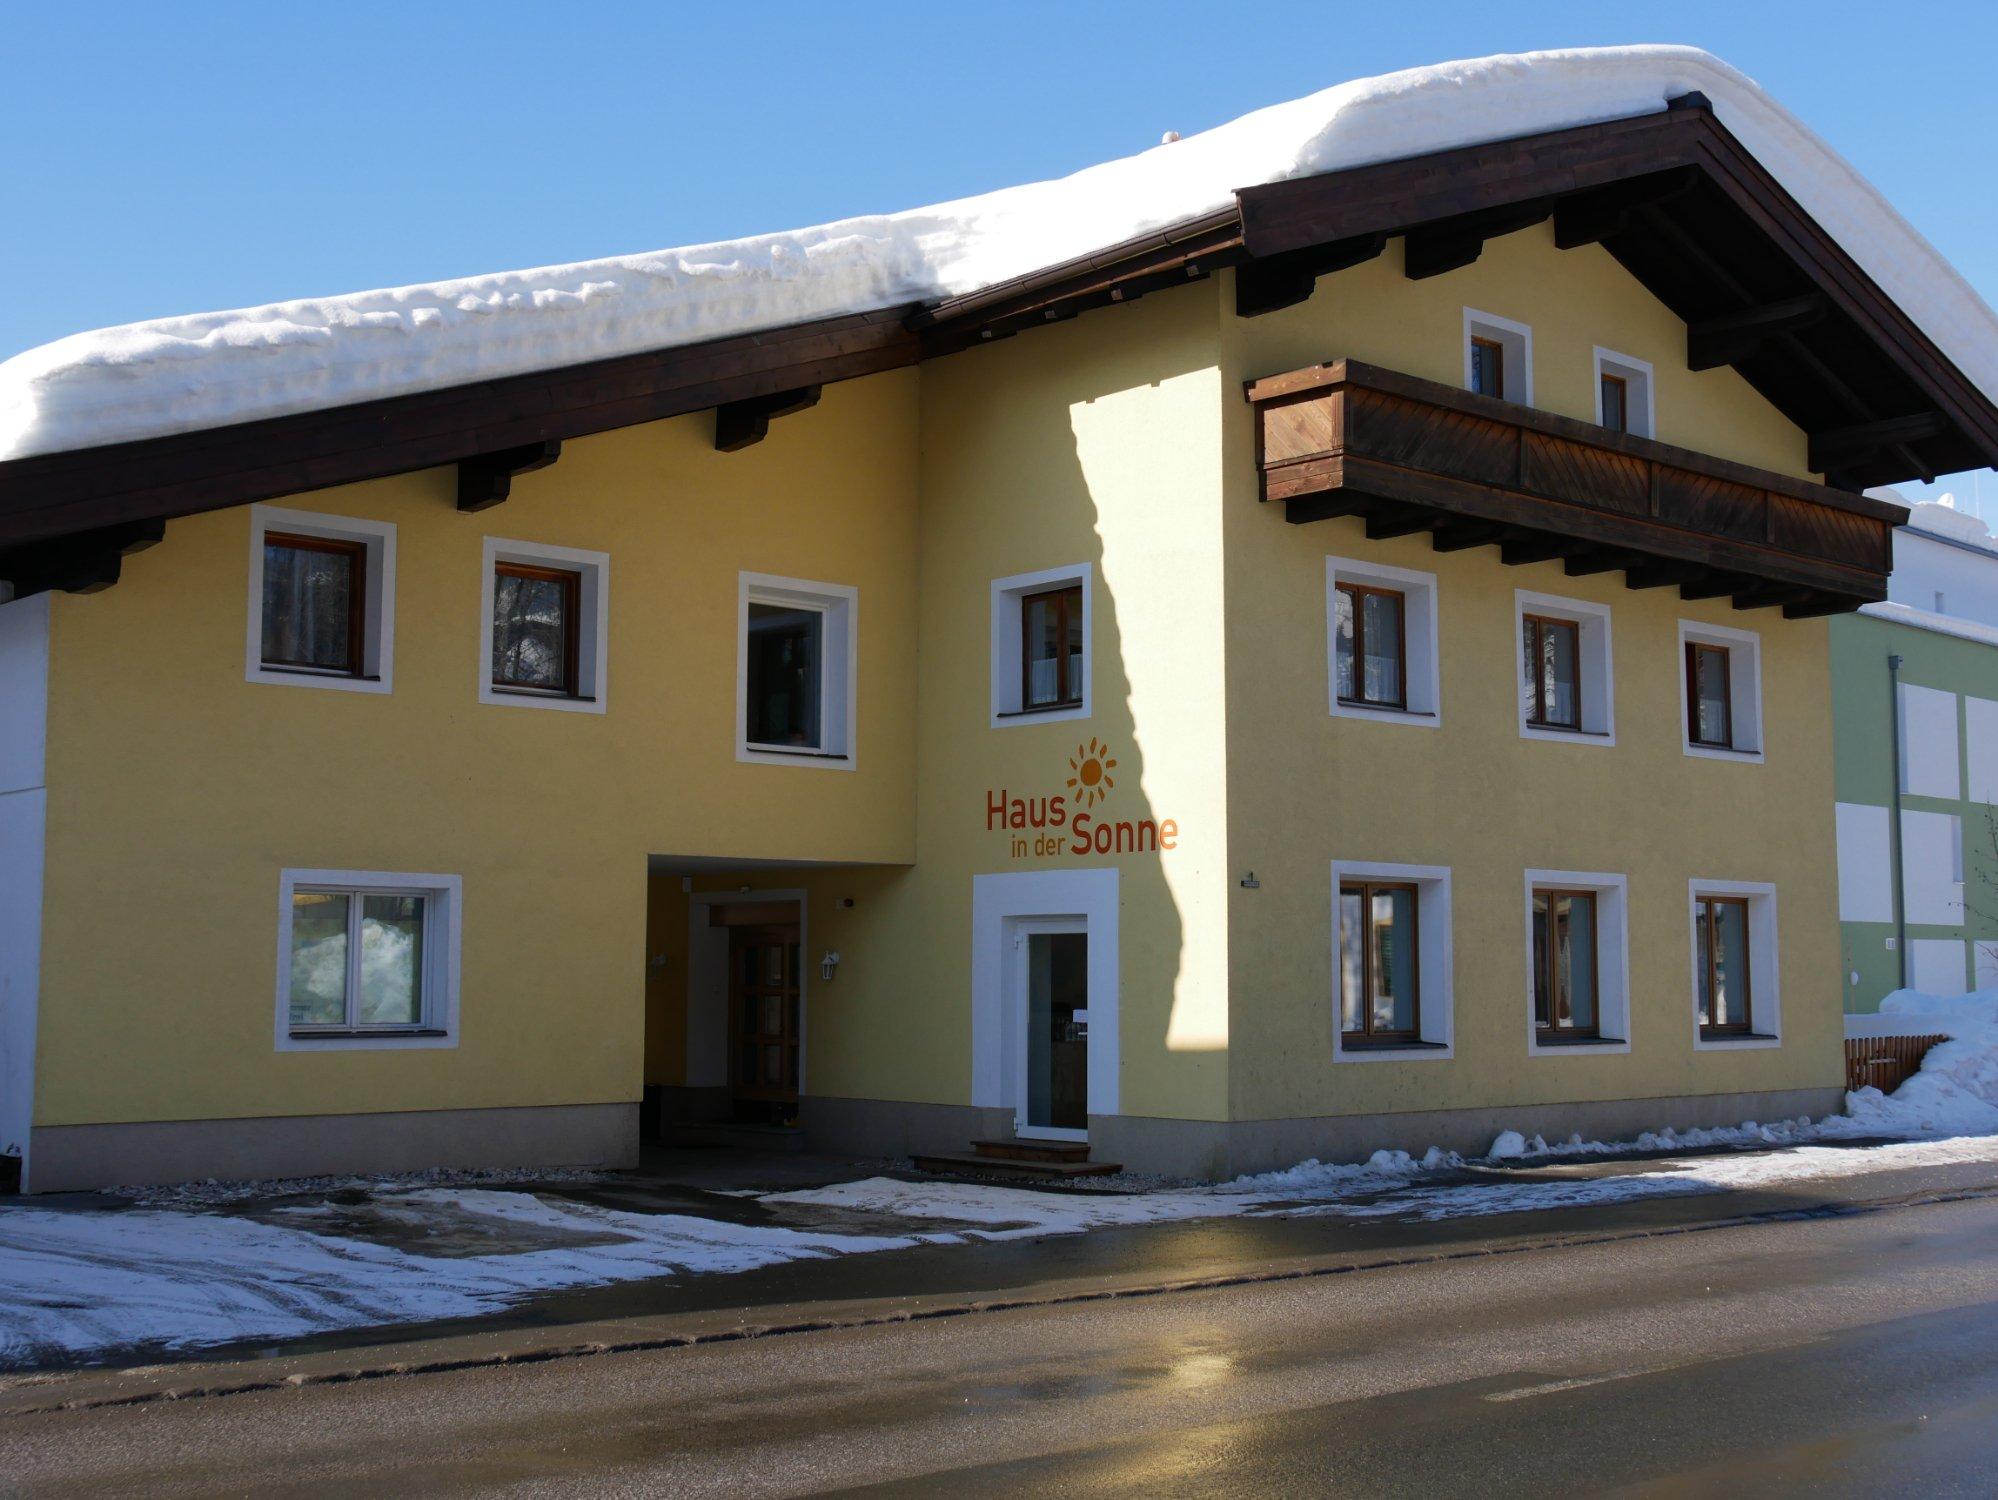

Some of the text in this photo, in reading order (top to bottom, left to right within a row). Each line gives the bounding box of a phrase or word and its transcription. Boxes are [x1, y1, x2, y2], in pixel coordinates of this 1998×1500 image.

[987, 789, 1067, 831] Haus
[1011, 832, 1066, 858] in der
[1070, 813, 1178, 855] Sonne
